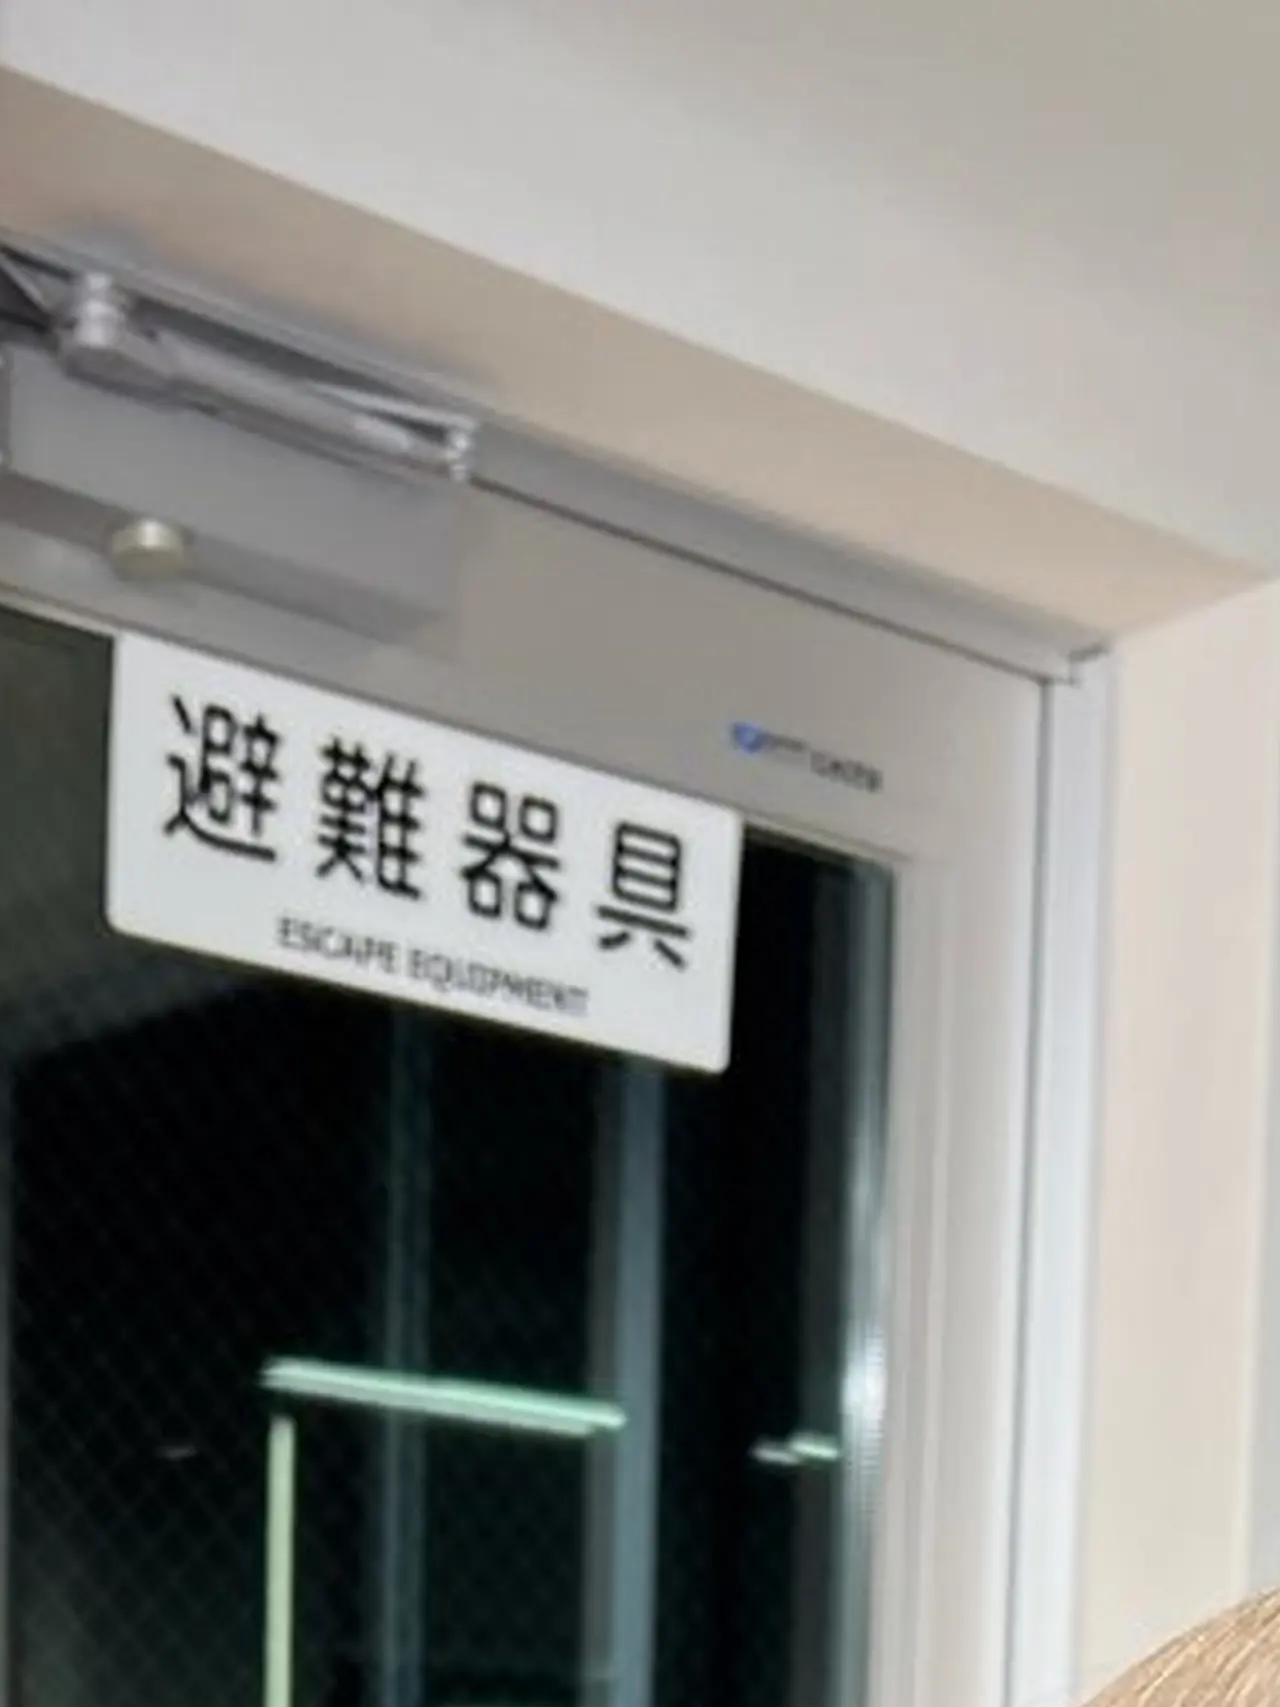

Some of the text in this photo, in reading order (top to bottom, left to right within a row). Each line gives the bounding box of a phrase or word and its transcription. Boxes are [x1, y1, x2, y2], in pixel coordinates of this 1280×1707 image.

[164, 697, 692, 970] 避難器具
[277, 916, 589, 1016] ESCAPE EQUIPMENT
